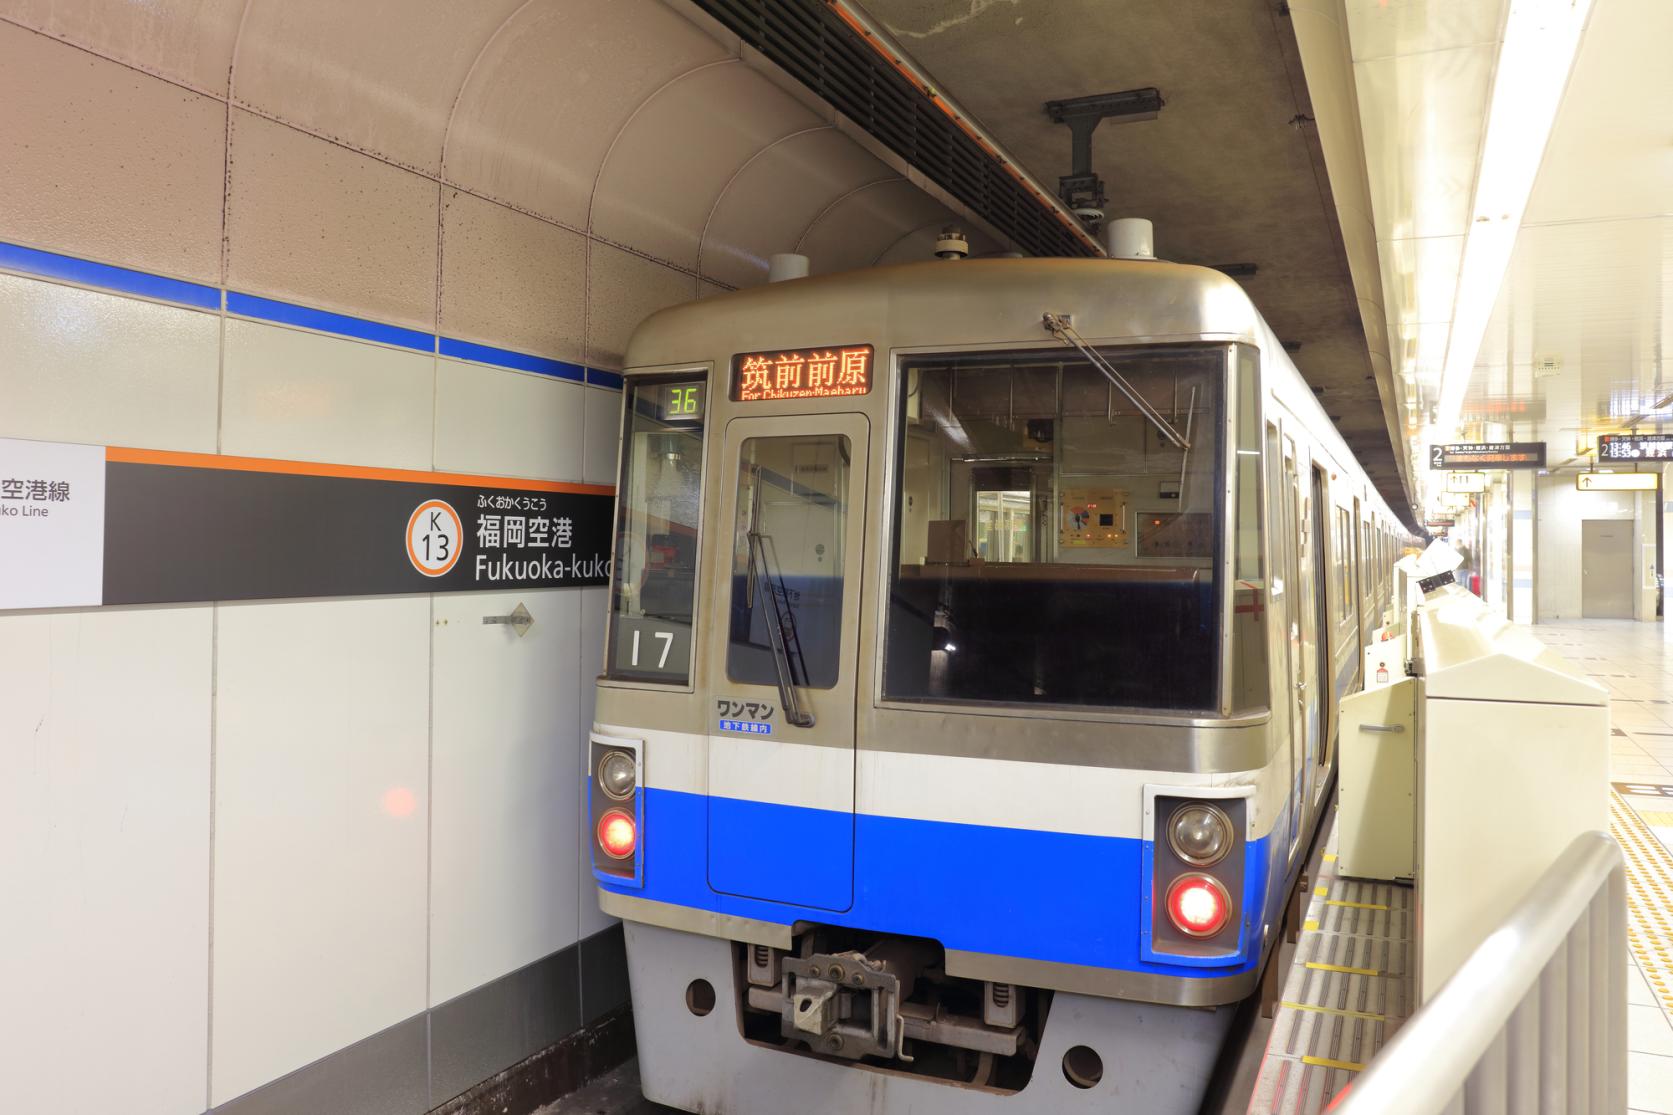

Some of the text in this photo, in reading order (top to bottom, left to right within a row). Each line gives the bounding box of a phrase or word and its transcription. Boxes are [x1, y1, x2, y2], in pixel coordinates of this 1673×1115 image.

[742, 349, 869, 389] 筑前前原
[670, 388, 697, 414] 36
[742, 391, 760, 400] For
[1432, 447, 1443, 462] 2
[1601, 444, 1608, 456] 2
[1, 478, 70, 502] 空港線
[0, 504, 49, 517] ko Line
[477, 495, 547, 511] ふくおかくうこう
[430, 511, 442, 532] K
[477, 514, 573, 549] 福岡空港
[422, 533, 449, 562] 13
[632, 630, 674, 669] 17
[717, 700, 774, 720] ワンマン
